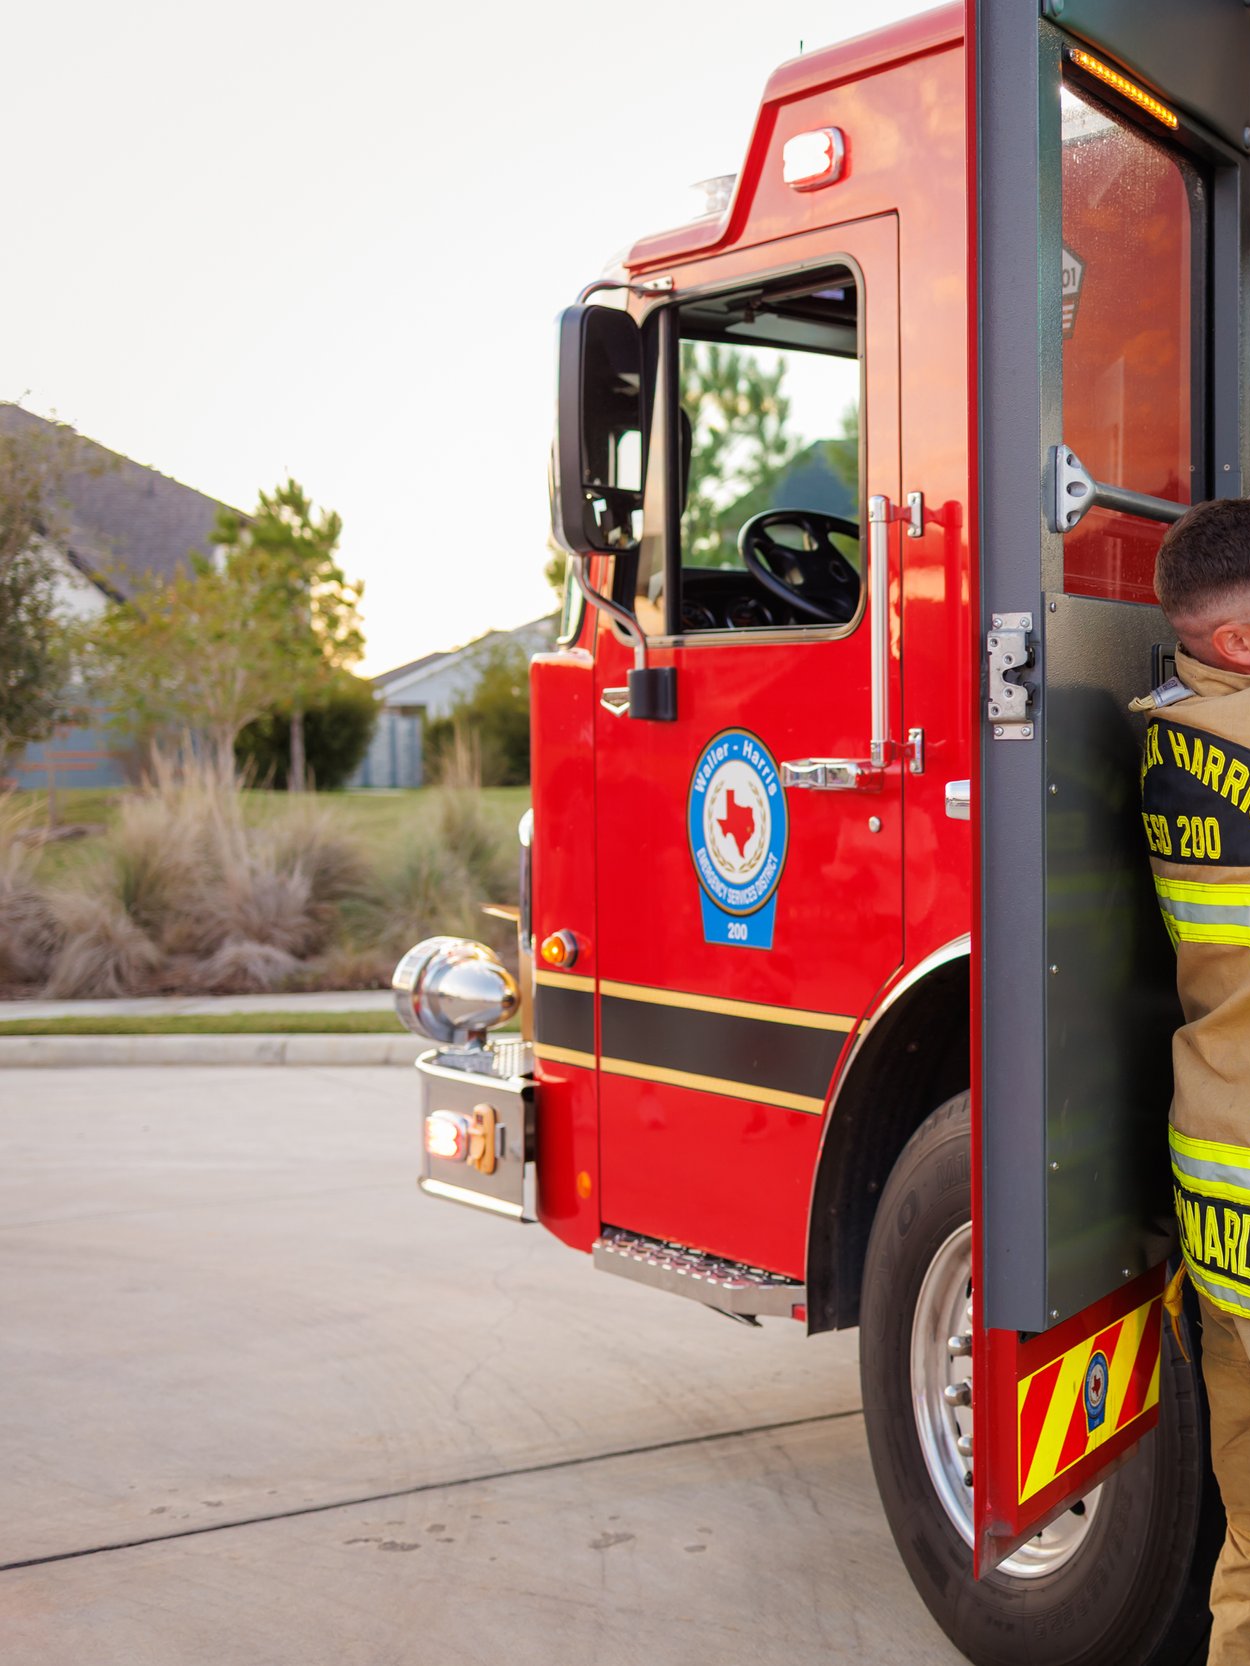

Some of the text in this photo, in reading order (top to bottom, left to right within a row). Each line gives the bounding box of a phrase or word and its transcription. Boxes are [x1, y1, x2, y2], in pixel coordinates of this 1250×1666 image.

[694, 743, 730, 794] Waller
[742, 739, 778, 797] Harris
[1142, 723, 1163, 777] ER
[1176, 815, 1222, 860] 200
[696, 847, 779, 906] EMERGENCY SERVICES DISTRICT
[727, 922, 748, 941] 200
